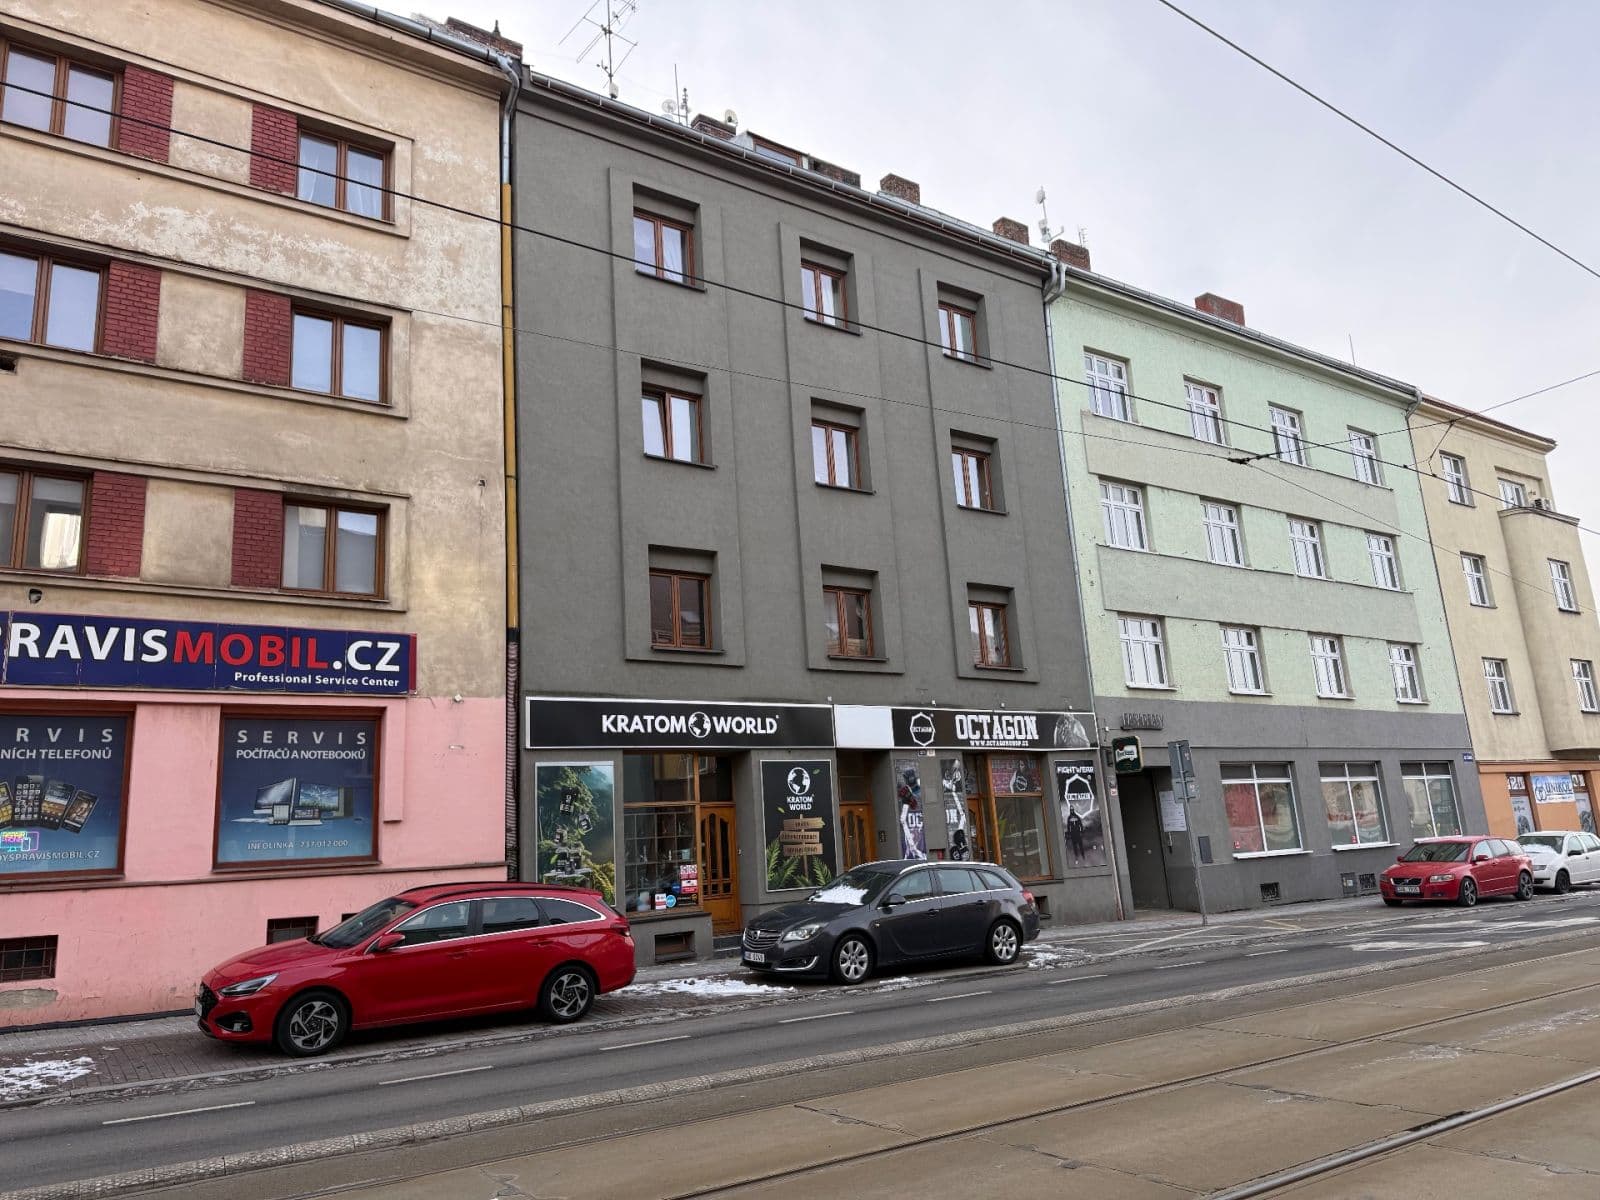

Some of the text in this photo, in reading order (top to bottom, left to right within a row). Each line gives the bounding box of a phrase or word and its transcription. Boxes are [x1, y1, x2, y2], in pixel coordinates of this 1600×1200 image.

[0, 622, 400, 672] RAVISMOBIL.CZ
[234, 672, 399, 687] Professional Service Center
[602, 715, 777, 734] KRATOM WORLD
[955, 714, 1039, 740] OCTAGON
[237, 730, 366, 745] SERVIS
[0, 747, 112, 759] NÍCH TELEFONŮ
[236, 747, 366, 760] POČÍTAČŮ A NOTEBOOKŮ
